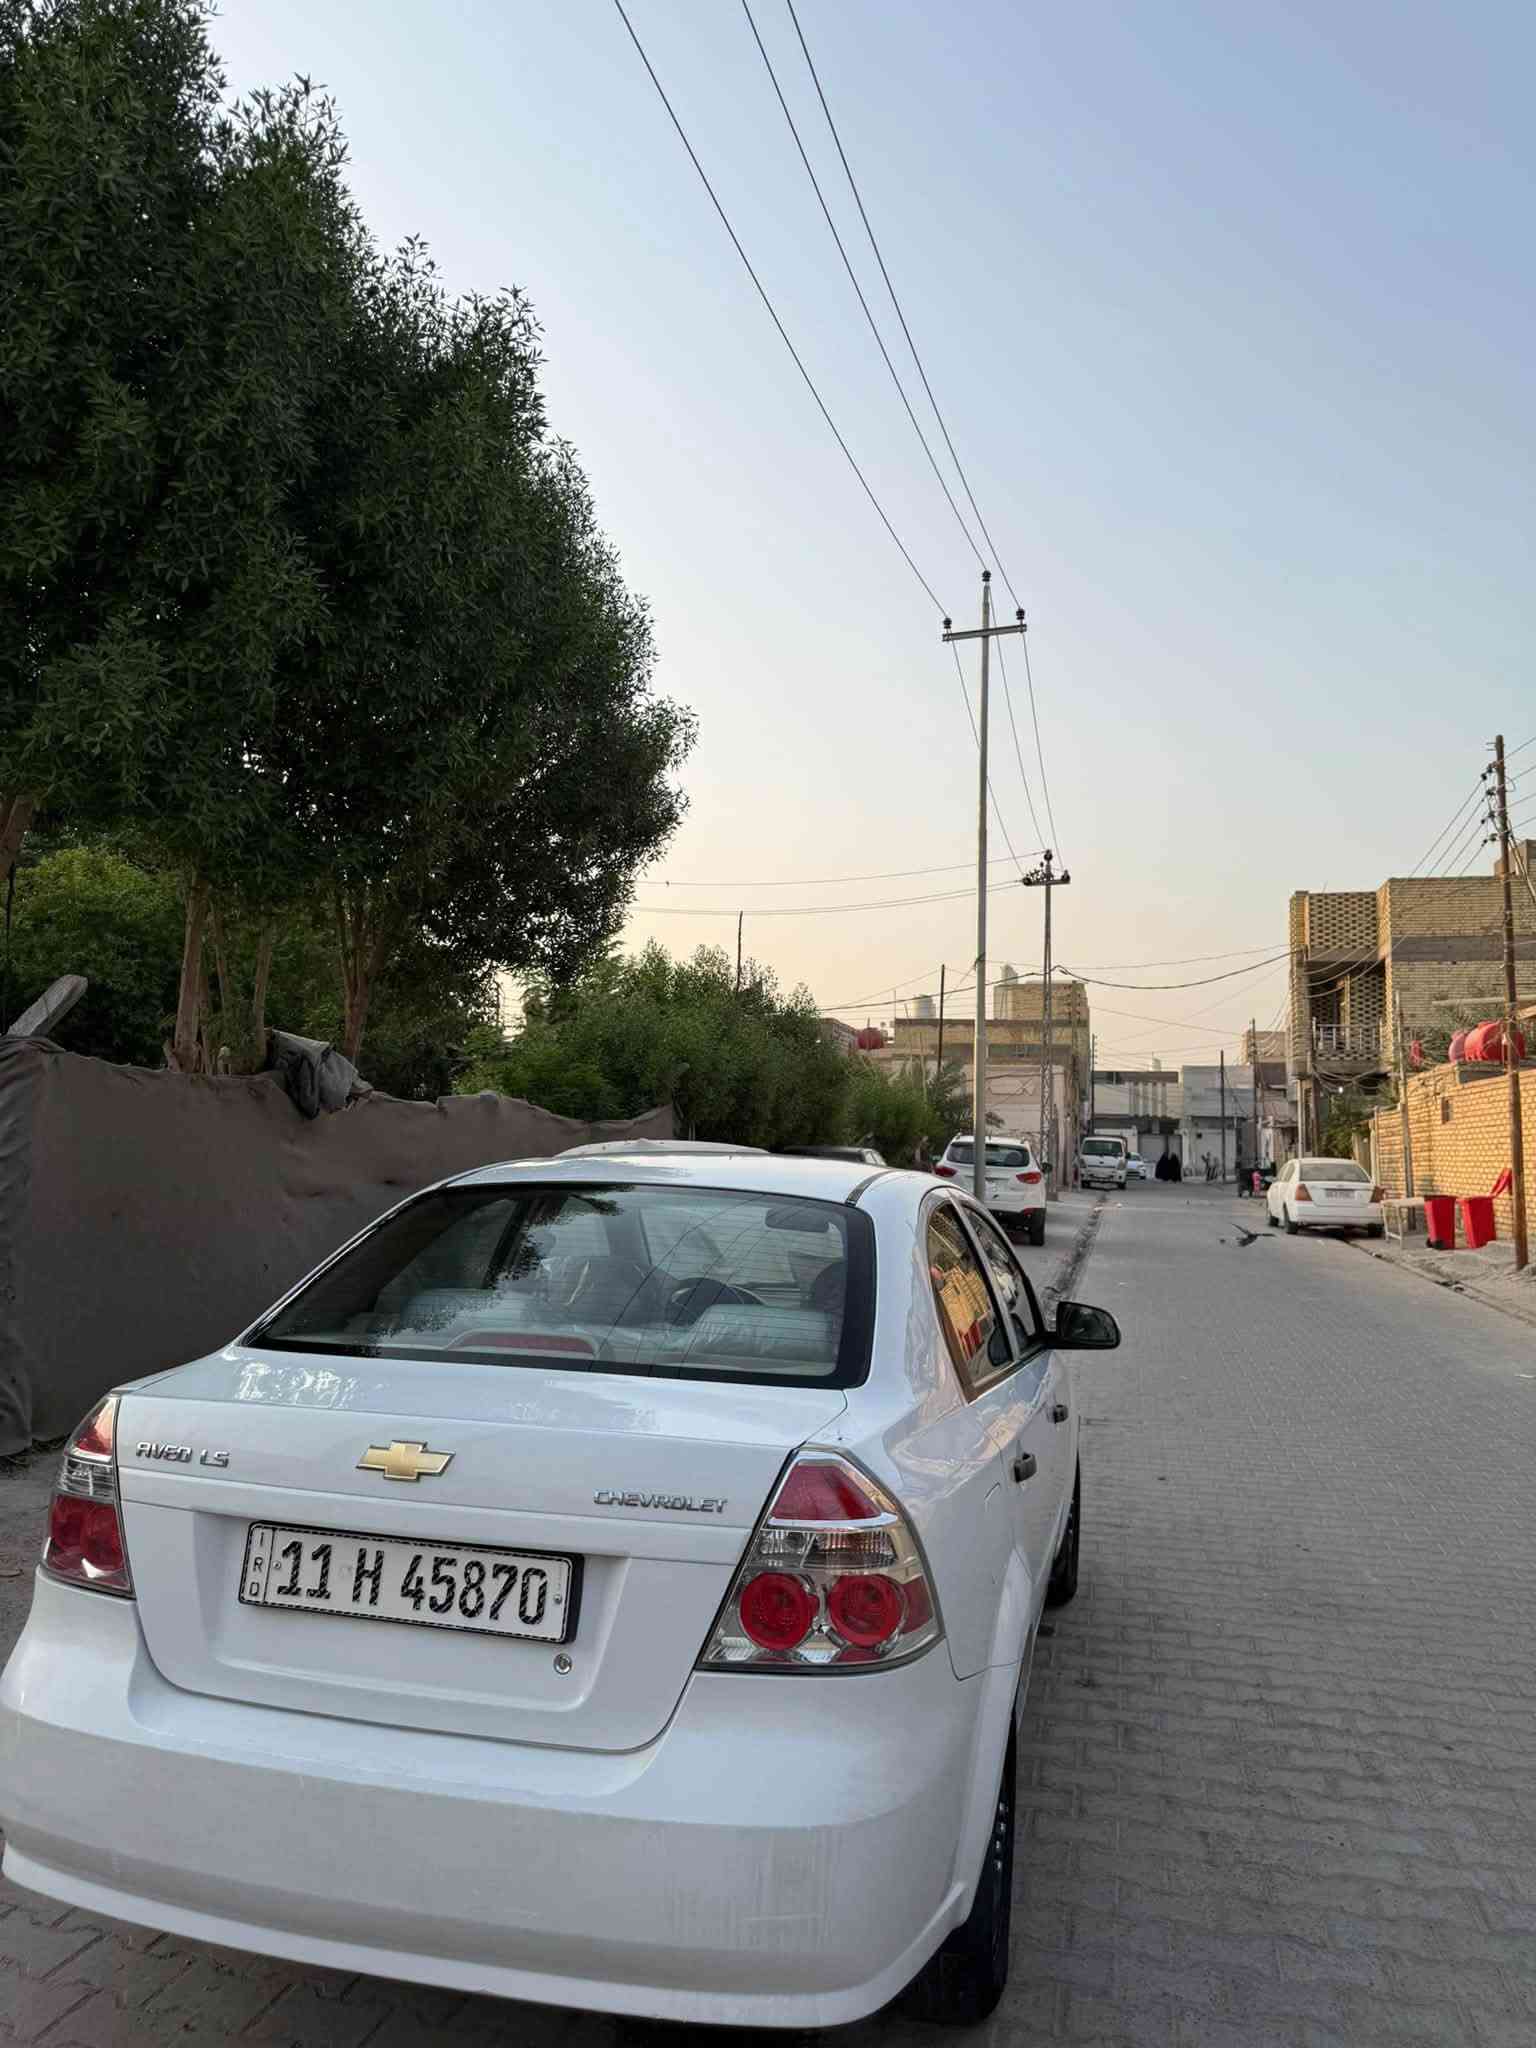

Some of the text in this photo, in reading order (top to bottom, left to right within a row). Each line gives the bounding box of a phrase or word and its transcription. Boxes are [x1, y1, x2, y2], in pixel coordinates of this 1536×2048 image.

[135, 1441, 230, 1468] AVEO LS
[593, 1489, 728, 1514] CHEVROLET
[276, 1540, 548, 1625] 11 H 45870
